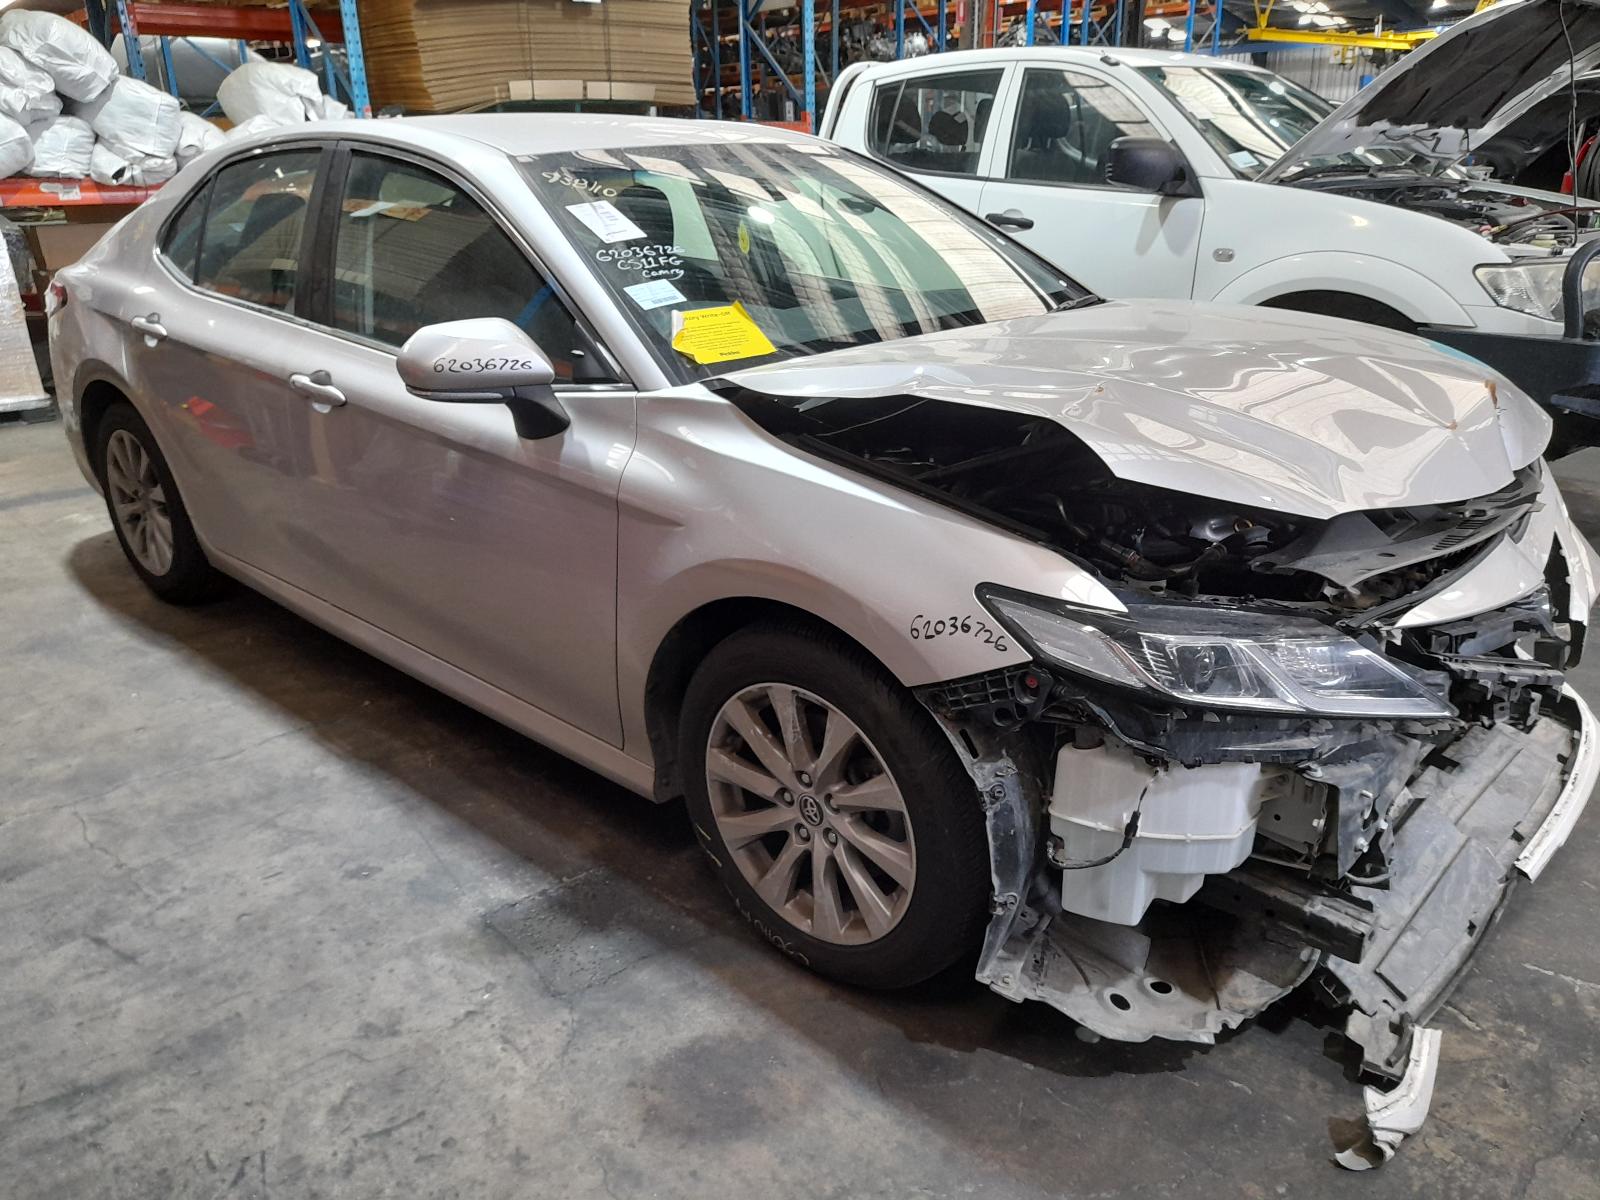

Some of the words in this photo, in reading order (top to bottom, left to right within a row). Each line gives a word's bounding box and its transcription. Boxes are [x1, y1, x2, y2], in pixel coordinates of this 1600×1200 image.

[596, 245, 685, 261] 62036726
[433, 358, 533, 373] 62036726
[910, 614, 1008, 651] 62036726
